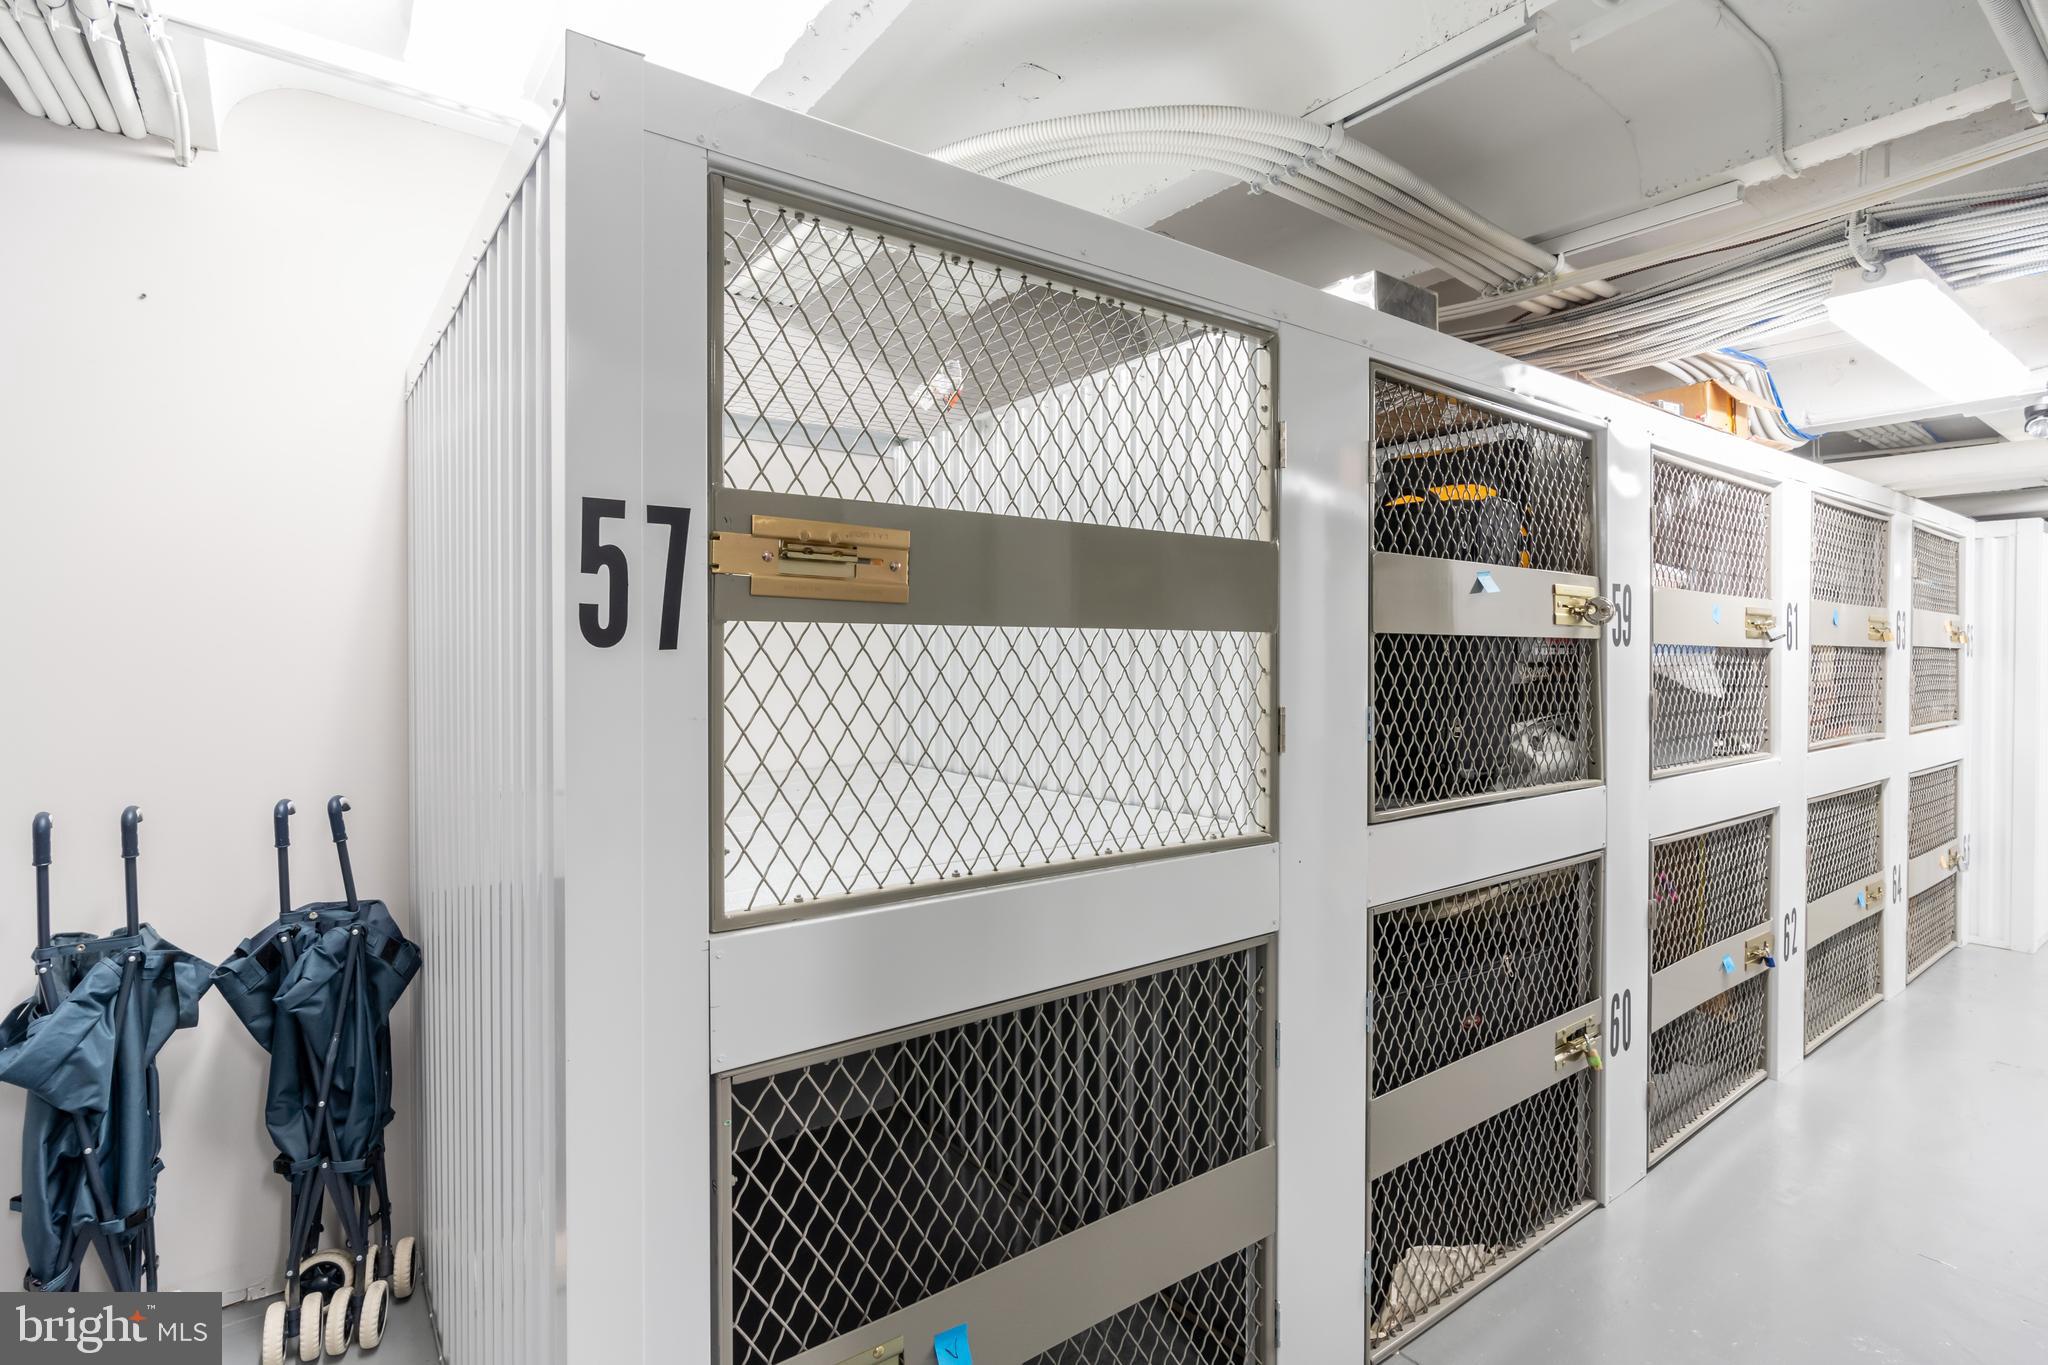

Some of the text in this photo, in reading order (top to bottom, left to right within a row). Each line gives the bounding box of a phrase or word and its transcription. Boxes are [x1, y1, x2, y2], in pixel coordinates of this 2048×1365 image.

[579, 497, 691, 650] 57
[1612, 584, 1632, 647] 59
[1787, 602, 1798, 651] 61
[1897, 610, 1905, 650] 63
[1893, 864, 1902, 904] 64
[1784, 907, 1797, 962] 62
[1610, 988, 1631, 1057] 60
